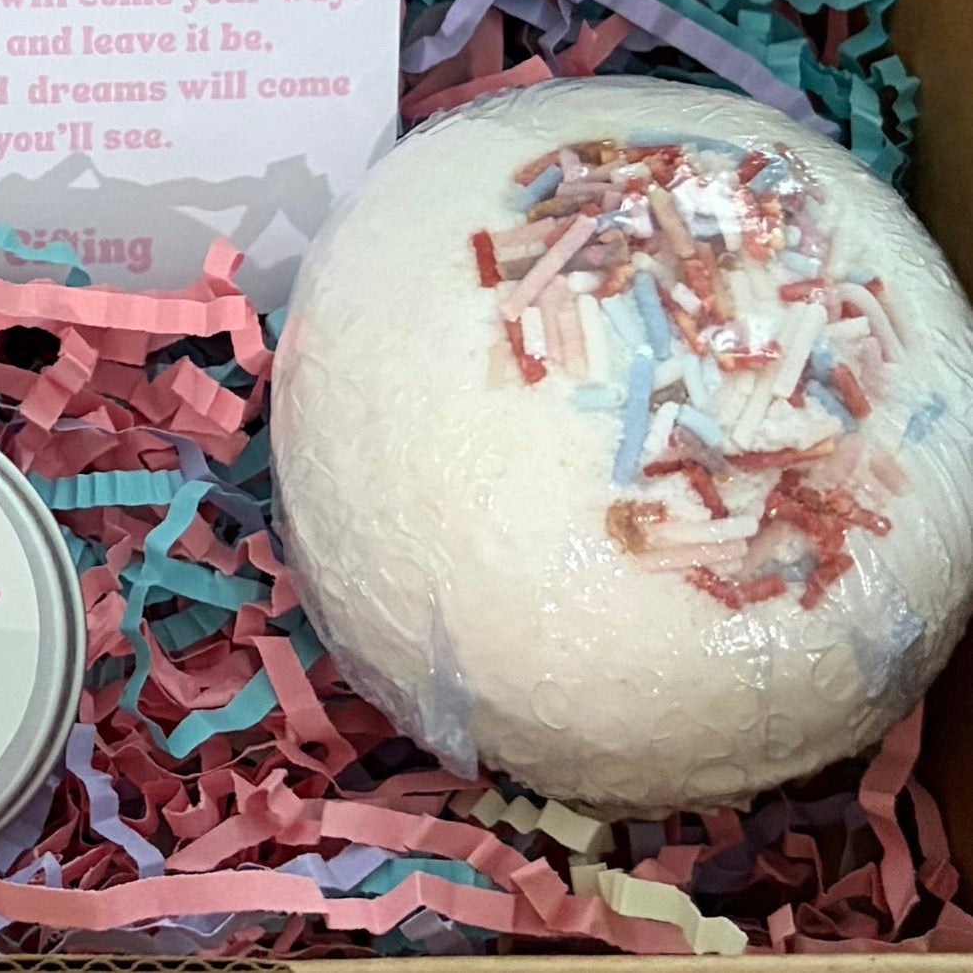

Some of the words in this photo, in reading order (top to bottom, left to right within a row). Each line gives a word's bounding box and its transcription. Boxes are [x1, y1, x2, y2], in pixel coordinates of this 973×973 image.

[5, 24, 73, 58] and
[82, 26, 176, 56] leave
[185, 23, 211, 53] it
[27, 74, 167, 106] dreams
[177, 70, 247, 100] will
[256, 76, 349, 99] come
[103, 128, 171, 152] see.
